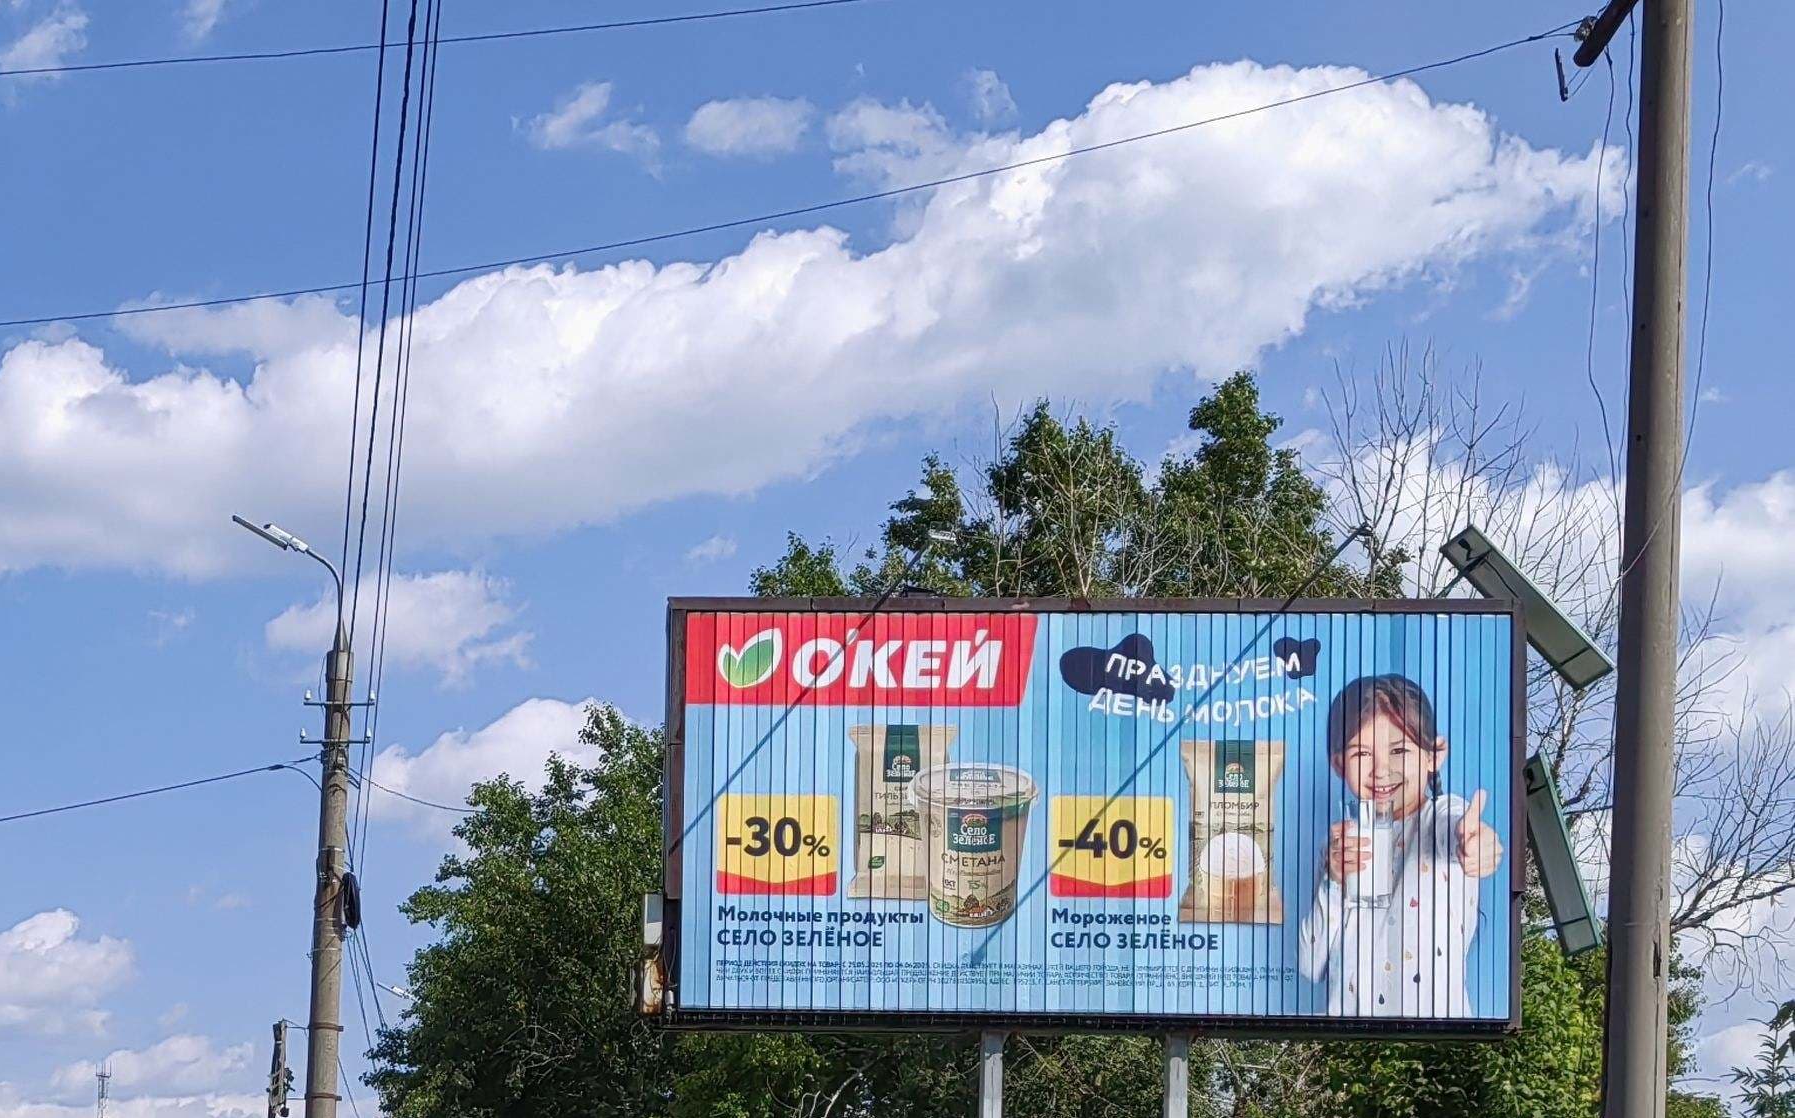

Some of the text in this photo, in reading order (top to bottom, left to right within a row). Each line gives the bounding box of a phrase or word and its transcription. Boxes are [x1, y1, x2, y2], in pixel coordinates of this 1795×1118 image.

[1105, 652, 1302, 693] ПРАЗДНУЕМ
[1089, 687, 1318, 727] ДЕНЬ МОЛОКА
[1211, 801, 1260, 810] ПЛОМБИР
[726, 817, 830, 858] -30%
[960, 824, 988, 837] Село
[1058, 819, 1167, 859] -40%
[941, 852, 1006, 868] СМЕТАНА
[718, 906, 924, 928] Молочные продукты
[1052, 908, 1172, 928] Мороженое
[717, 926, 883, 947] СЕЛО ЗЕЛЁНОЕ
[1051, 929, 1219, 950] СЕЛО ЗЕЛЁНОЕ
